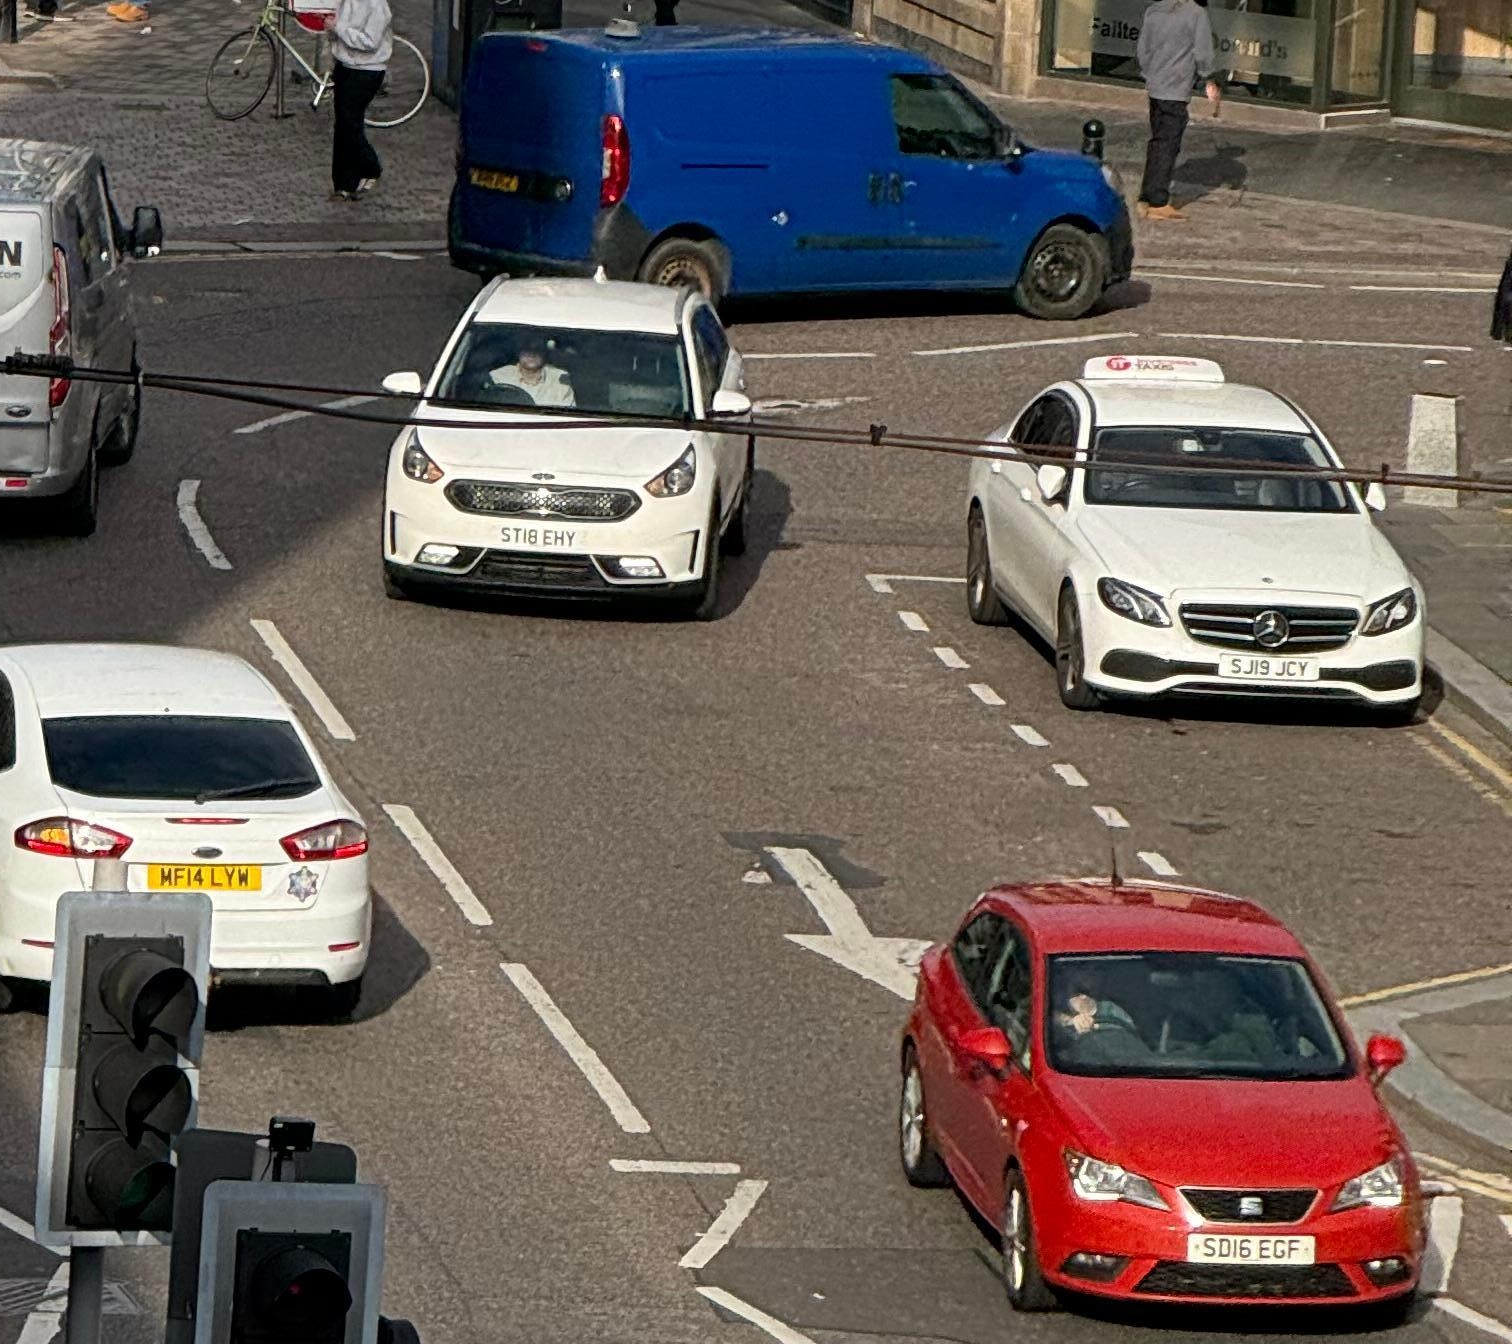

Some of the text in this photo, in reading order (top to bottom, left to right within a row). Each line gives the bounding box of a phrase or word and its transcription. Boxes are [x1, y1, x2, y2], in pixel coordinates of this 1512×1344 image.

[501, 527, 576, 547] ST18 EHY
[1230, 658, 1309, 677] SJ19 JCY
[159, 867, 249, 888] MF14 LYW
[1203, 1237, 1301, 1259] SD16 EGF
